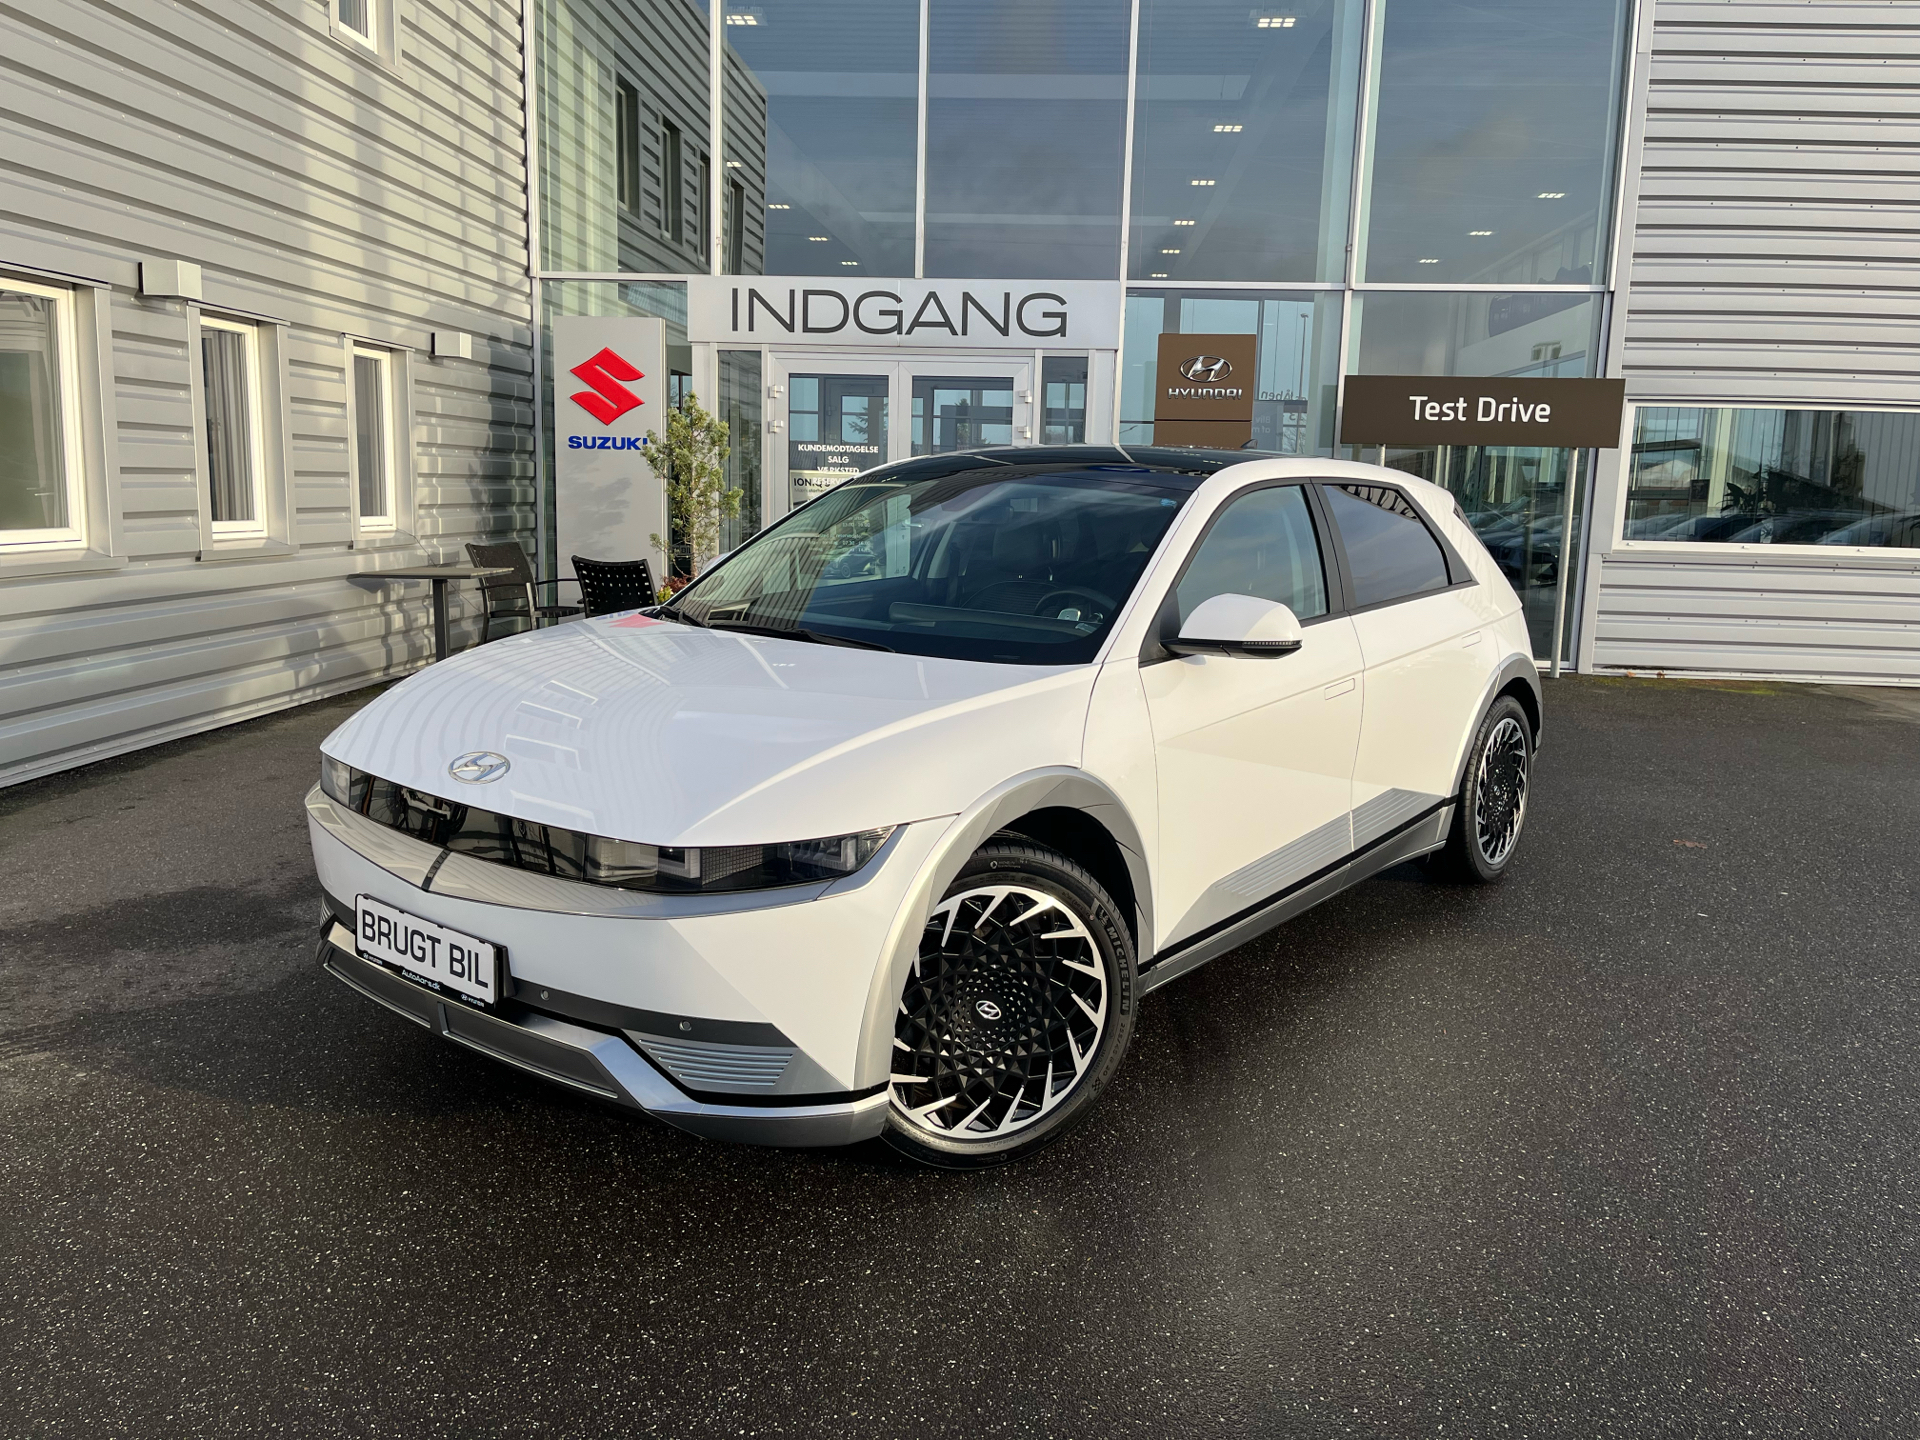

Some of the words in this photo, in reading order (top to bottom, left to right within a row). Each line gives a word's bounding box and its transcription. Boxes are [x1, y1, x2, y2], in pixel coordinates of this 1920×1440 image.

[731, 288, 1067, 337] INDGANG
[1168, 388, 1242, 400] HYUNDAI
[1409, 396, 1467, 421] Test
[1477, 396, 1551, 423] Drive
[798, 444, 879, 453] KUNDEMODTAGELSE
[362, 909, 441, 968] BRUGT
[450, 943, 488, 989] BIL
[1106, 926, 1130, 1013] MICHELIN
